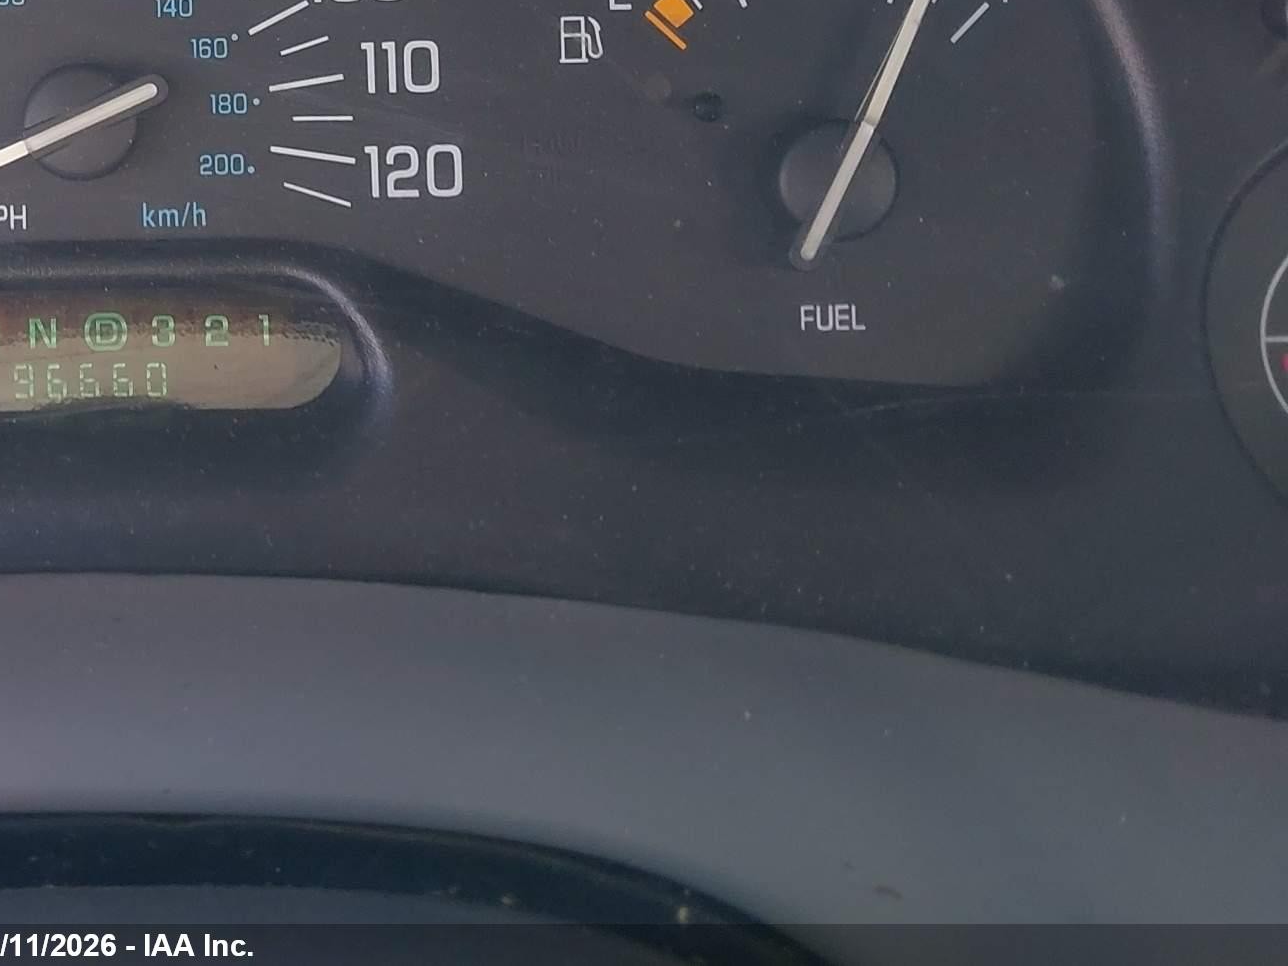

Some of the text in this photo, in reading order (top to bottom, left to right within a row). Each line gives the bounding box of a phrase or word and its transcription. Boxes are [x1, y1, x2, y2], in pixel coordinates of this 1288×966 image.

[192, 38, 227, 58] 160
[361, 41, 439, 93] 110
[211, 93, 247, 114] 180
[200, 154, 244, 174] 200
[365, 145, 462, 197] 120
[143, 202, 206, 227] km/h
[29, 318, 57, 348] N
[152, 315, 175, 346] 3
[206, 315, 229, 346] 2
[259, 314, 270, 346] 1
[801, 305, 865, 331] FUEL
[14, 363, 168, 398] 96660
